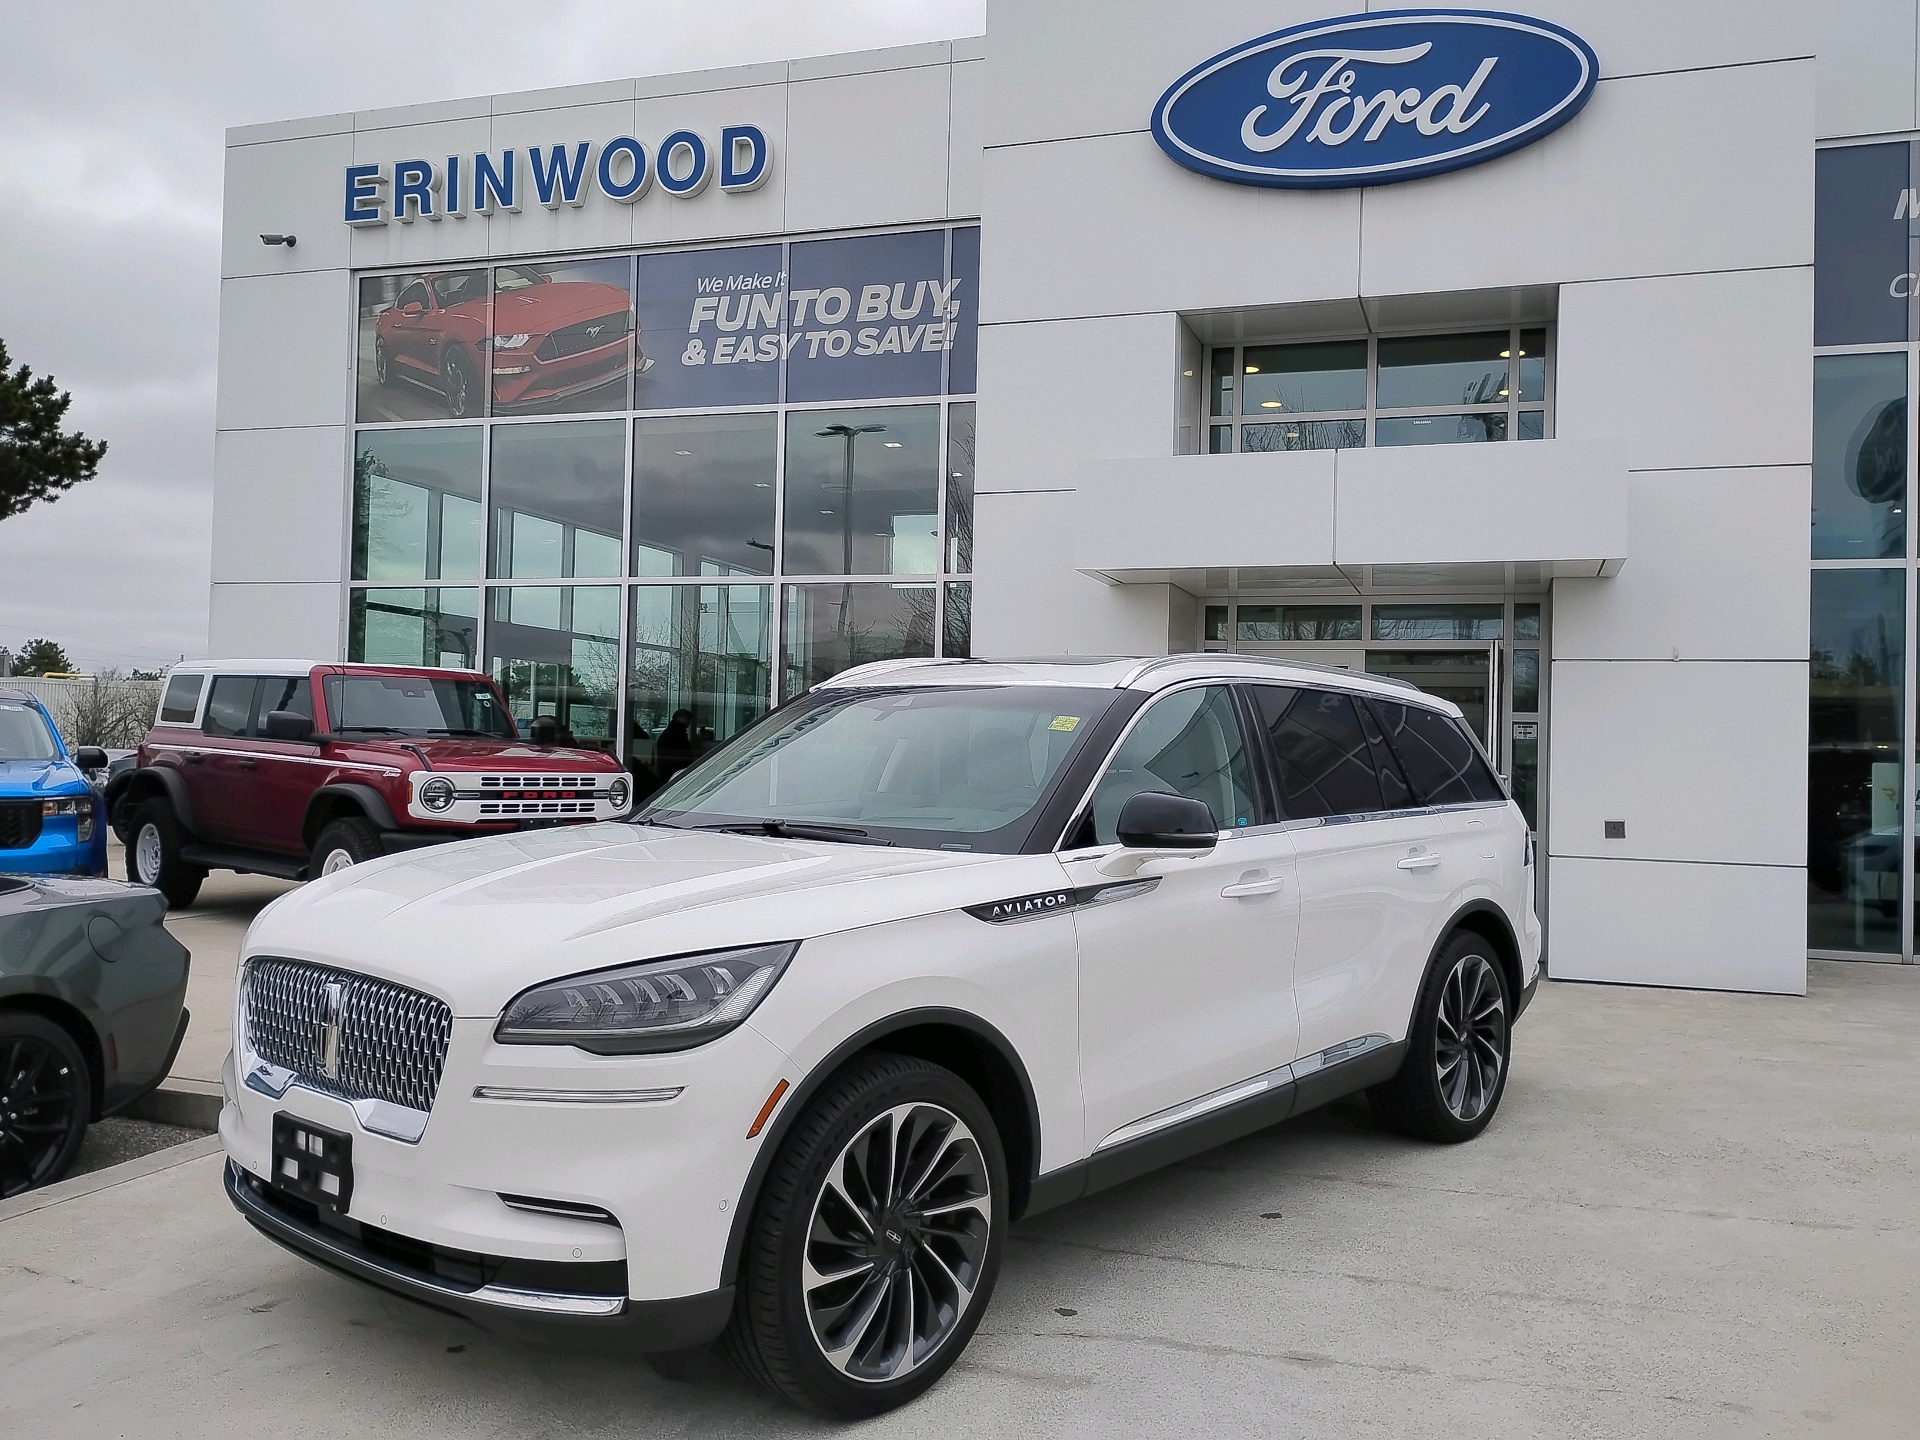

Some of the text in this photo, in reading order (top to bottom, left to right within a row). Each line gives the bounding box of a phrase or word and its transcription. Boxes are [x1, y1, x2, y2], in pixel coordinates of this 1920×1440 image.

[1241, 41, 1499, 152] Ford
[344, 123, 772, 227] ERINWOOD
[697, 270, 787, 294] We Make It
[688, 278, 962, 333] FUN TO BUY,
[681, 321, 958, 366] & EASY TO SAVE!
[503, 791, 576, 799] FORD
[991, 893, 1067, 917] AVIATOR
